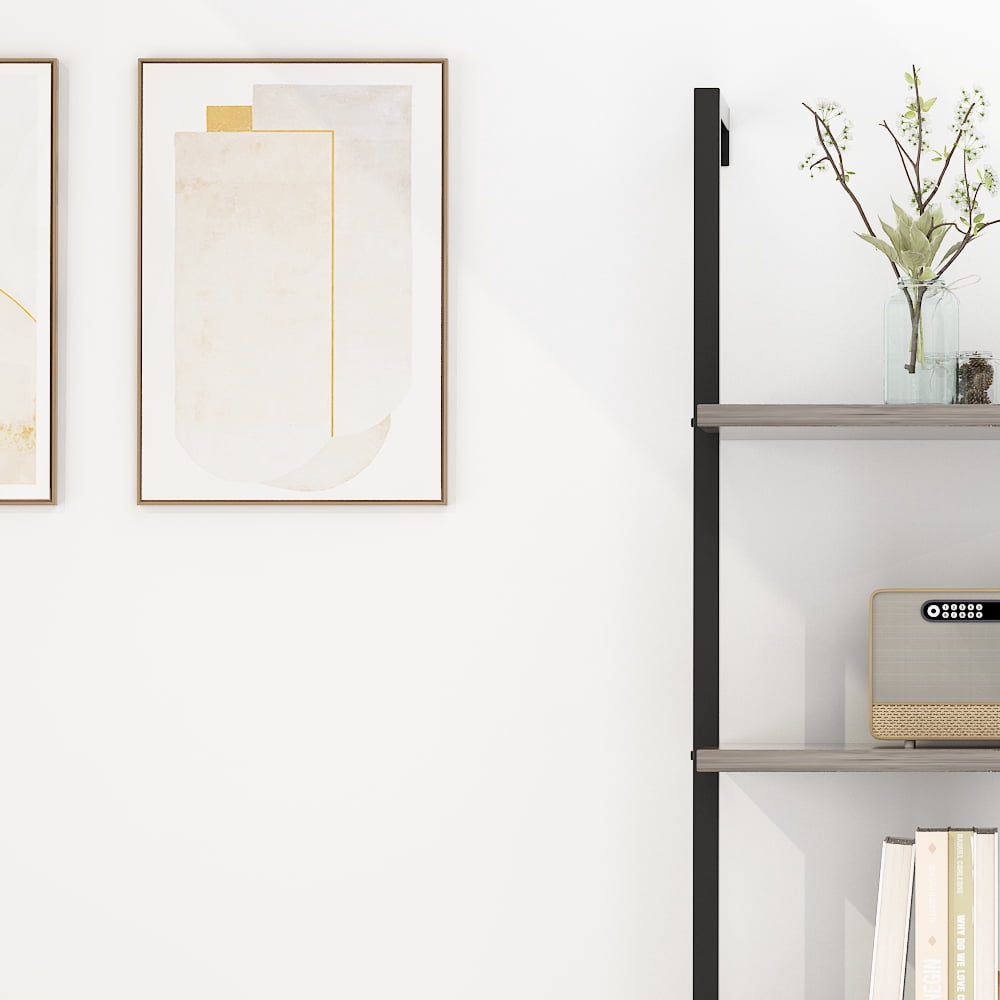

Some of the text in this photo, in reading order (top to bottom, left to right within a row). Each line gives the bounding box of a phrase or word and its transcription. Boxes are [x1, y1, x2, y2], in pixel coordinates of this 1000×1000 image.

[957, 914, 966, 937] WHY
[957, 938, 966, 950] DO
[957, 952, 966, 968] WE
[957, 970, 966, 993] LOVE
